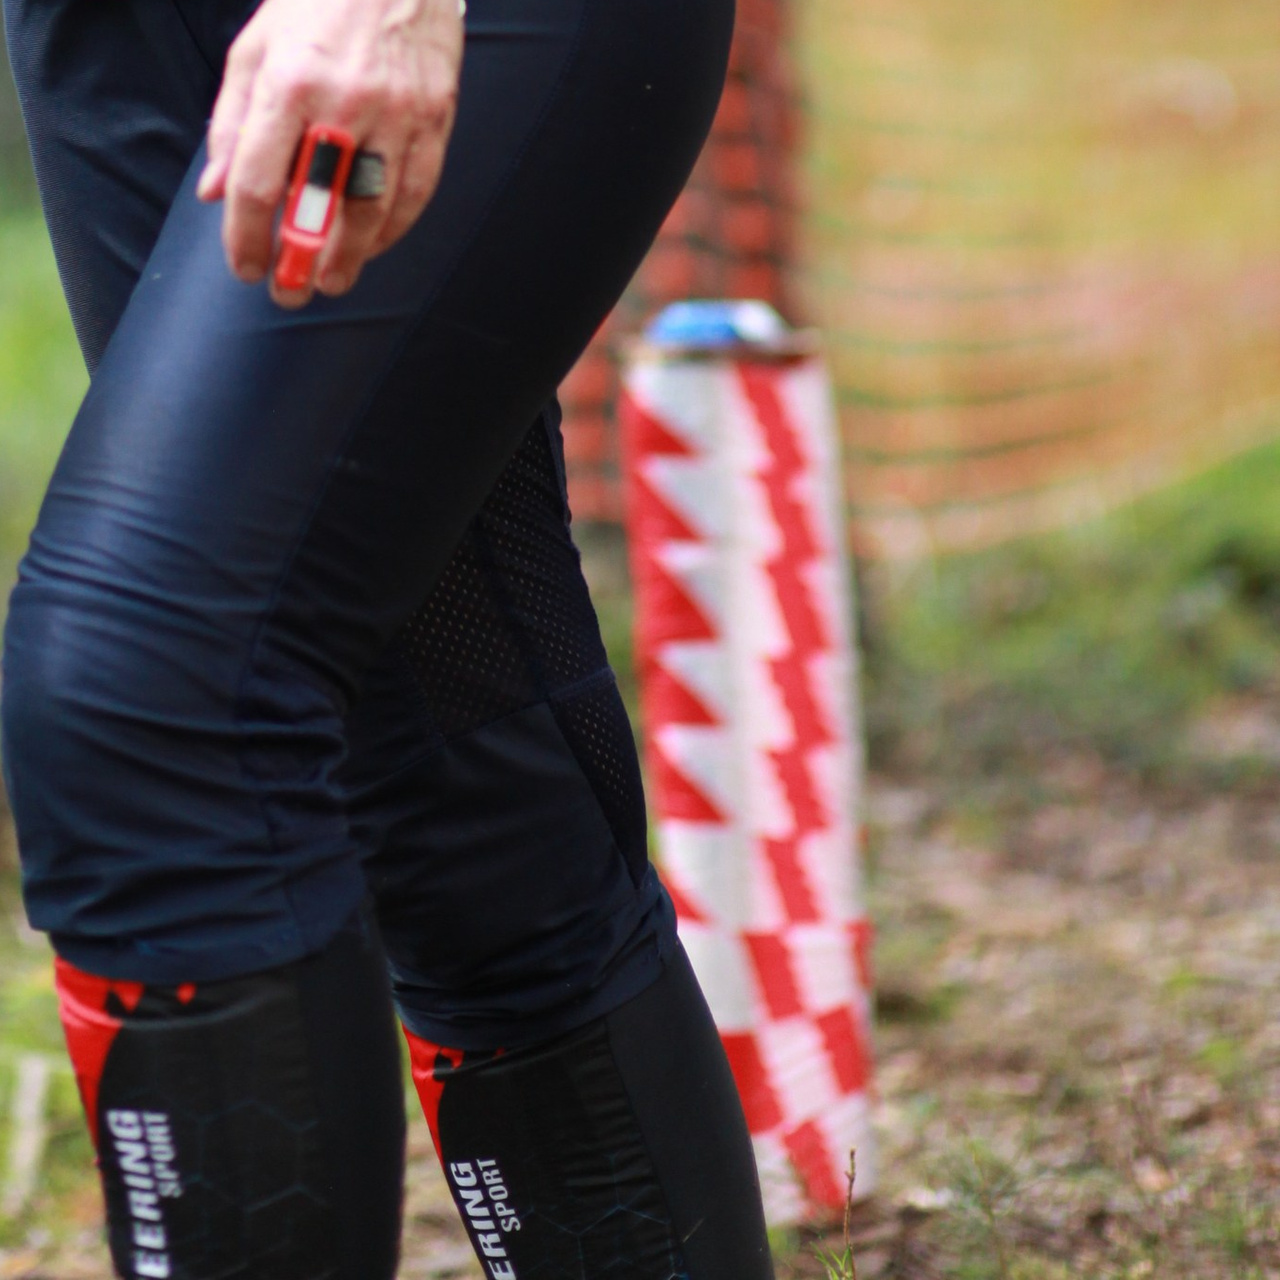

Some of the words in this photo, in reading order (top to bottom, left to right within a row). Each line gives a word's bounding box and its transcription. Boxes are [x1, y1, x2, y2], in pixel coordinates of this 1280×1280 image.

[106, 1109, 170, 1280] EERING
[142, 1111, 183, 1198] SPORT
[476, 1158, 521, 1233] SPORT
